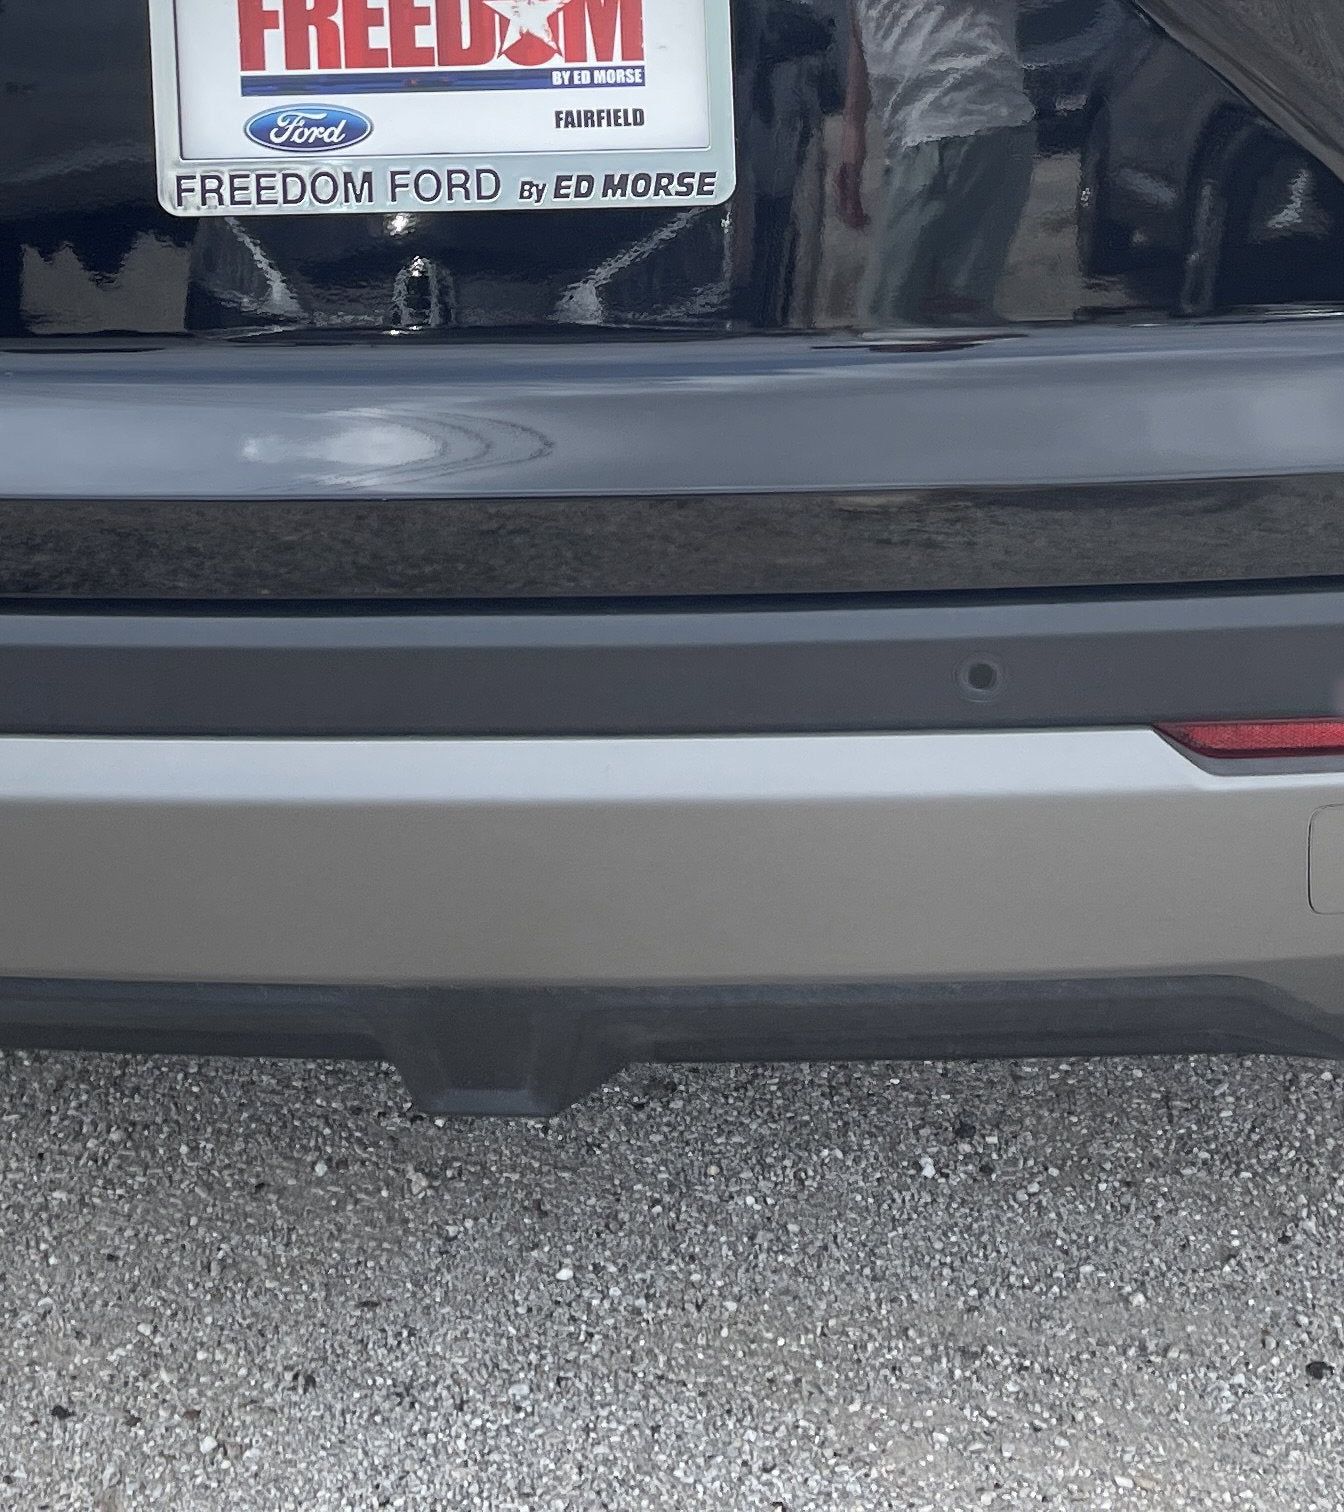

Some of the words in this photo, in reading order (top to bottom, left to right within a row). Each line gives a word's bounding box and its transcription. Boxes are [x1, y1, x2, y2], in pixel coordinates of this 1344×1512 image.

[551, 70, 571, 86] BY
[573, 69, 592, 85] ED
[594, 67, 643, 85] MORSE
[267, 110, 348, 147] Ford
[554, 107, 645, 129] FAIRFIELD
[175, 170, 375, 207] FREEDOM
[389, 168, 502, 204] FORD
[518, 179, 547, 204] By
[552, 174, 595, 200] ED
[601, 171, 718, 199] MORSE
